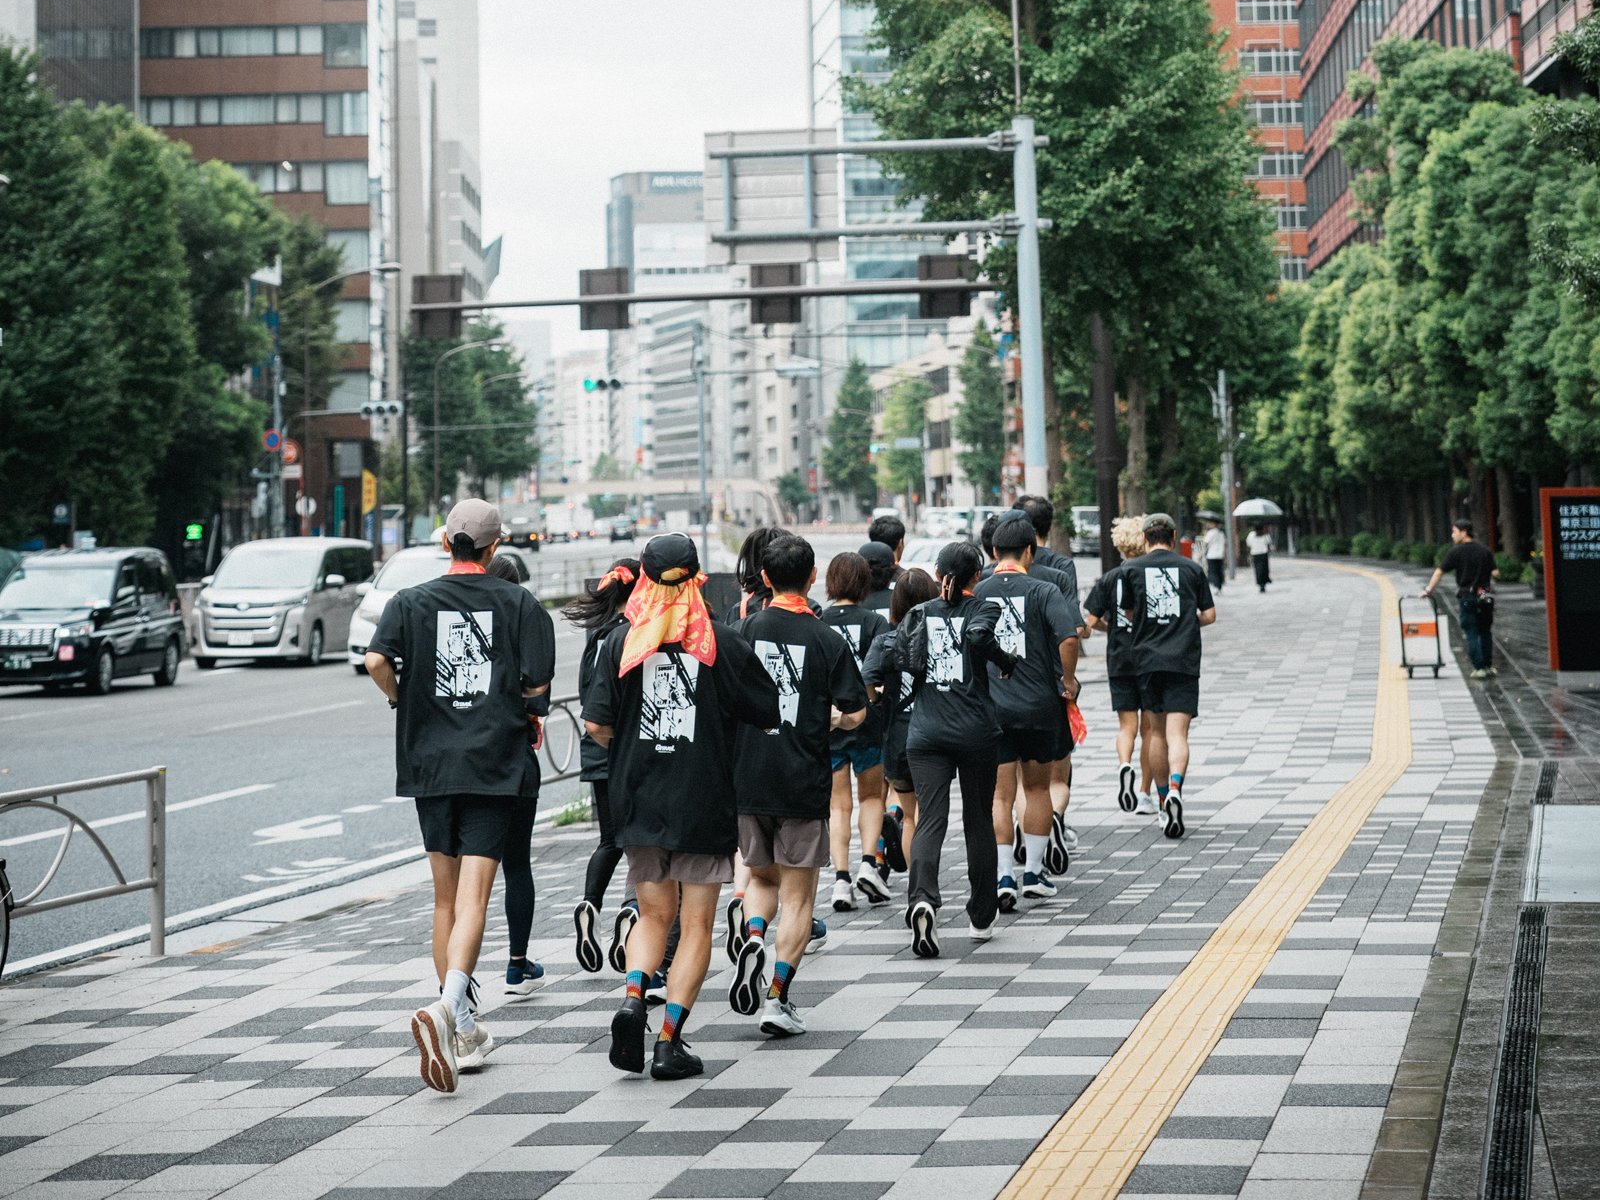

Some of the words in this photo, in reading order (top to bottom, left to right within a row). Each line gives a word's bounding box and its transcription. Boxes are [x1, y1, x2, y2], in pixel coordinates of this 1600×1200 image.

[676, 175, 704, 187] HOTE
[1559, 504, 1600, 516] 住友不動
